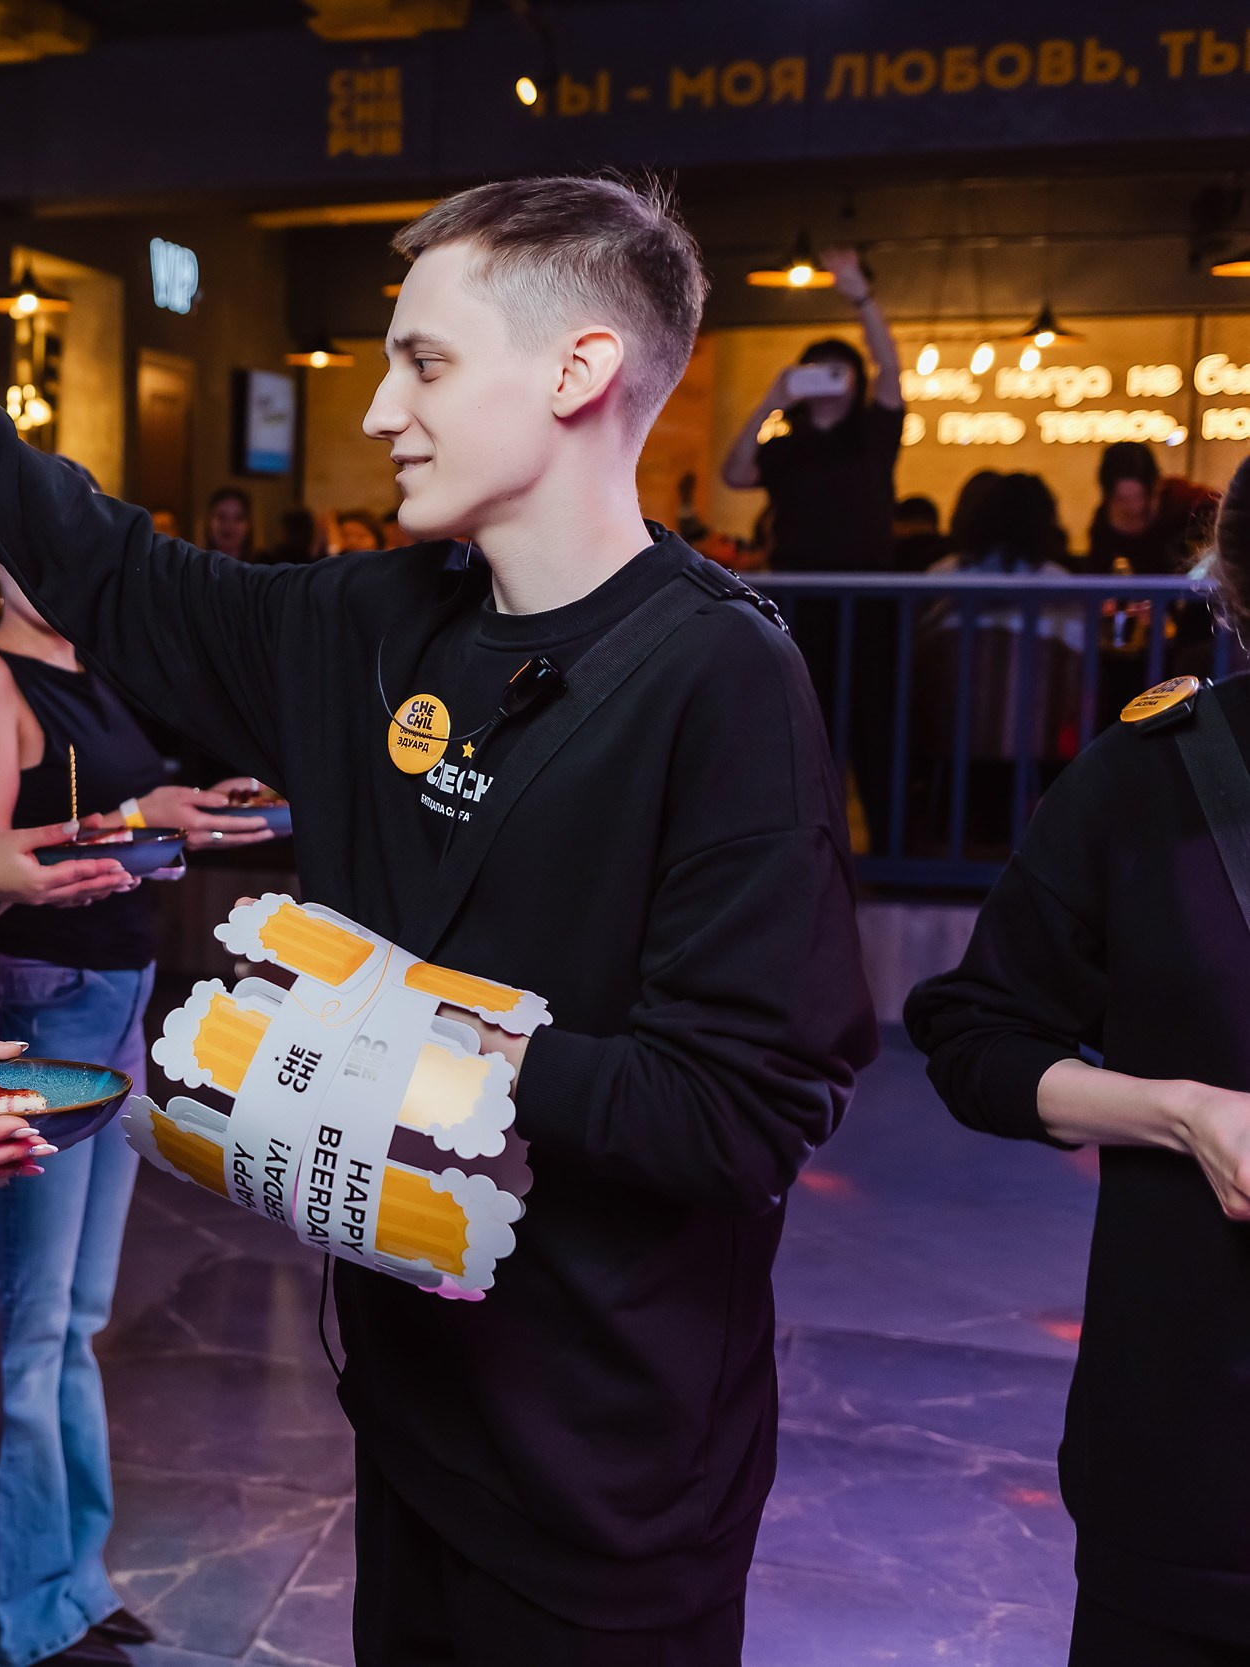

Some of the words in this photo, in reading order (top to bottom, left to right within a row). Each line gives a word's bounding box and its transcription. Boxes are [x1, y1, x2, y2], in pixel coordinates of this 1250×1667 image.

[668, 57, 807, 111] МОЯ
[824, 37, 1140, 99] ЛЮБОВЬ,
[406, 713, 432, 730] CHIL
[411, 700, 436, 717] CHE
[397, 737, 430, 753] ЭДУАРД
[277, 1044, 306, 1086] CHE
[293, 1050, 323, 1093] CHIL
[341, 1159, 372, 1256] HAPPY
